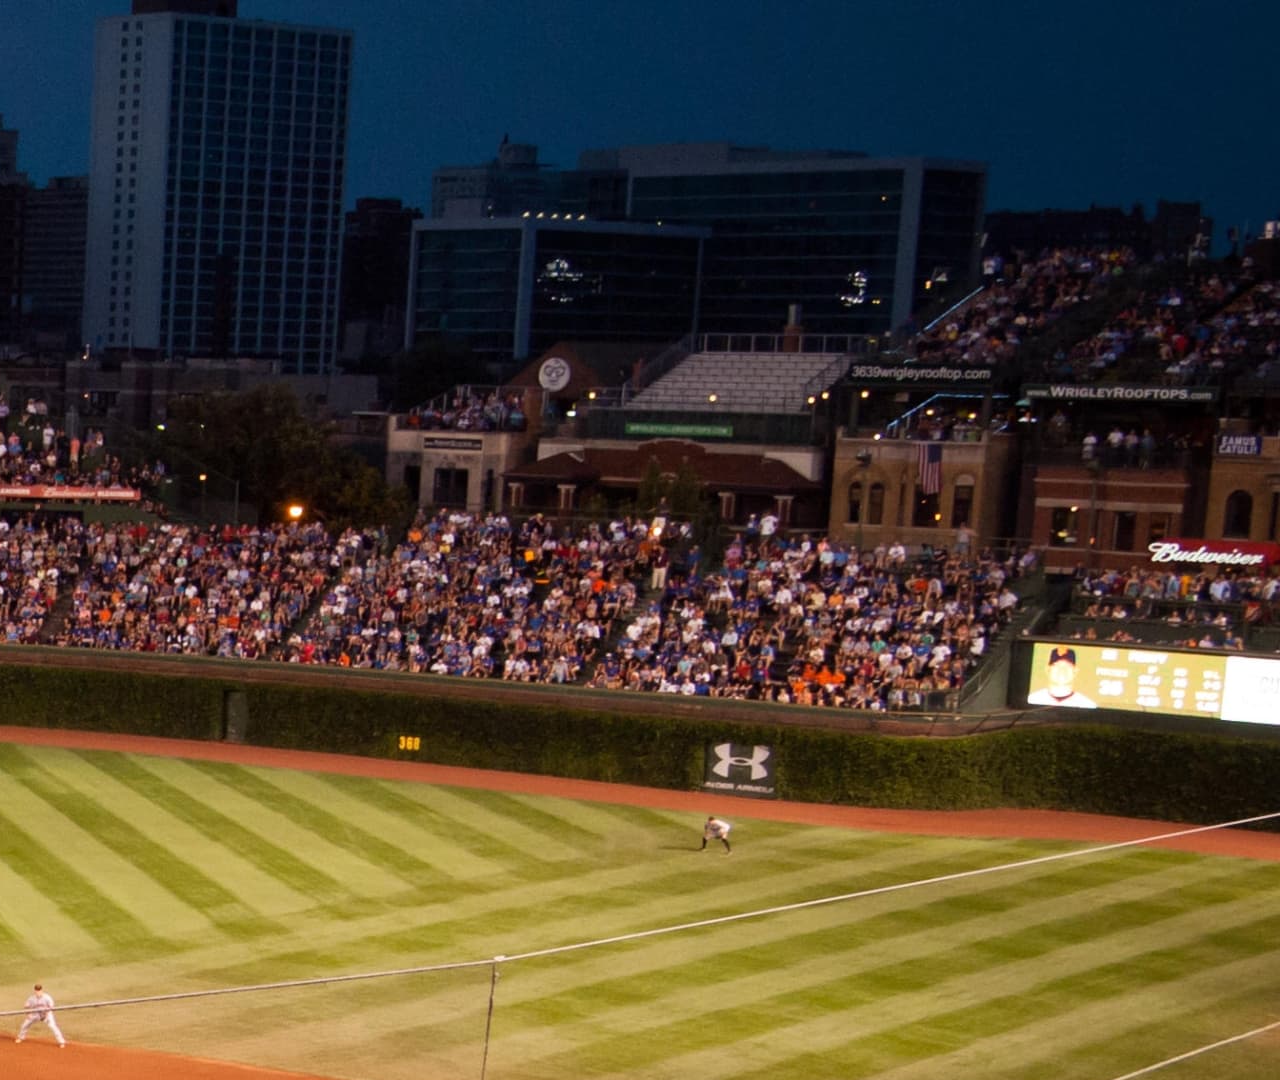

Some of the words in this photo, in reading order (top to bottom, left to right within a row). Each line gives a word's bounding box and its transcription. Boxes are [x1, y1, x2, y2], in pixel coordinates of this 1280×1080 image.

[851, 366, 992, 381] 3639wrigleyrooftop.com
[43, 486, 96, 497] Budweiser
[1148, 542, 1264, 565] Budweiser
